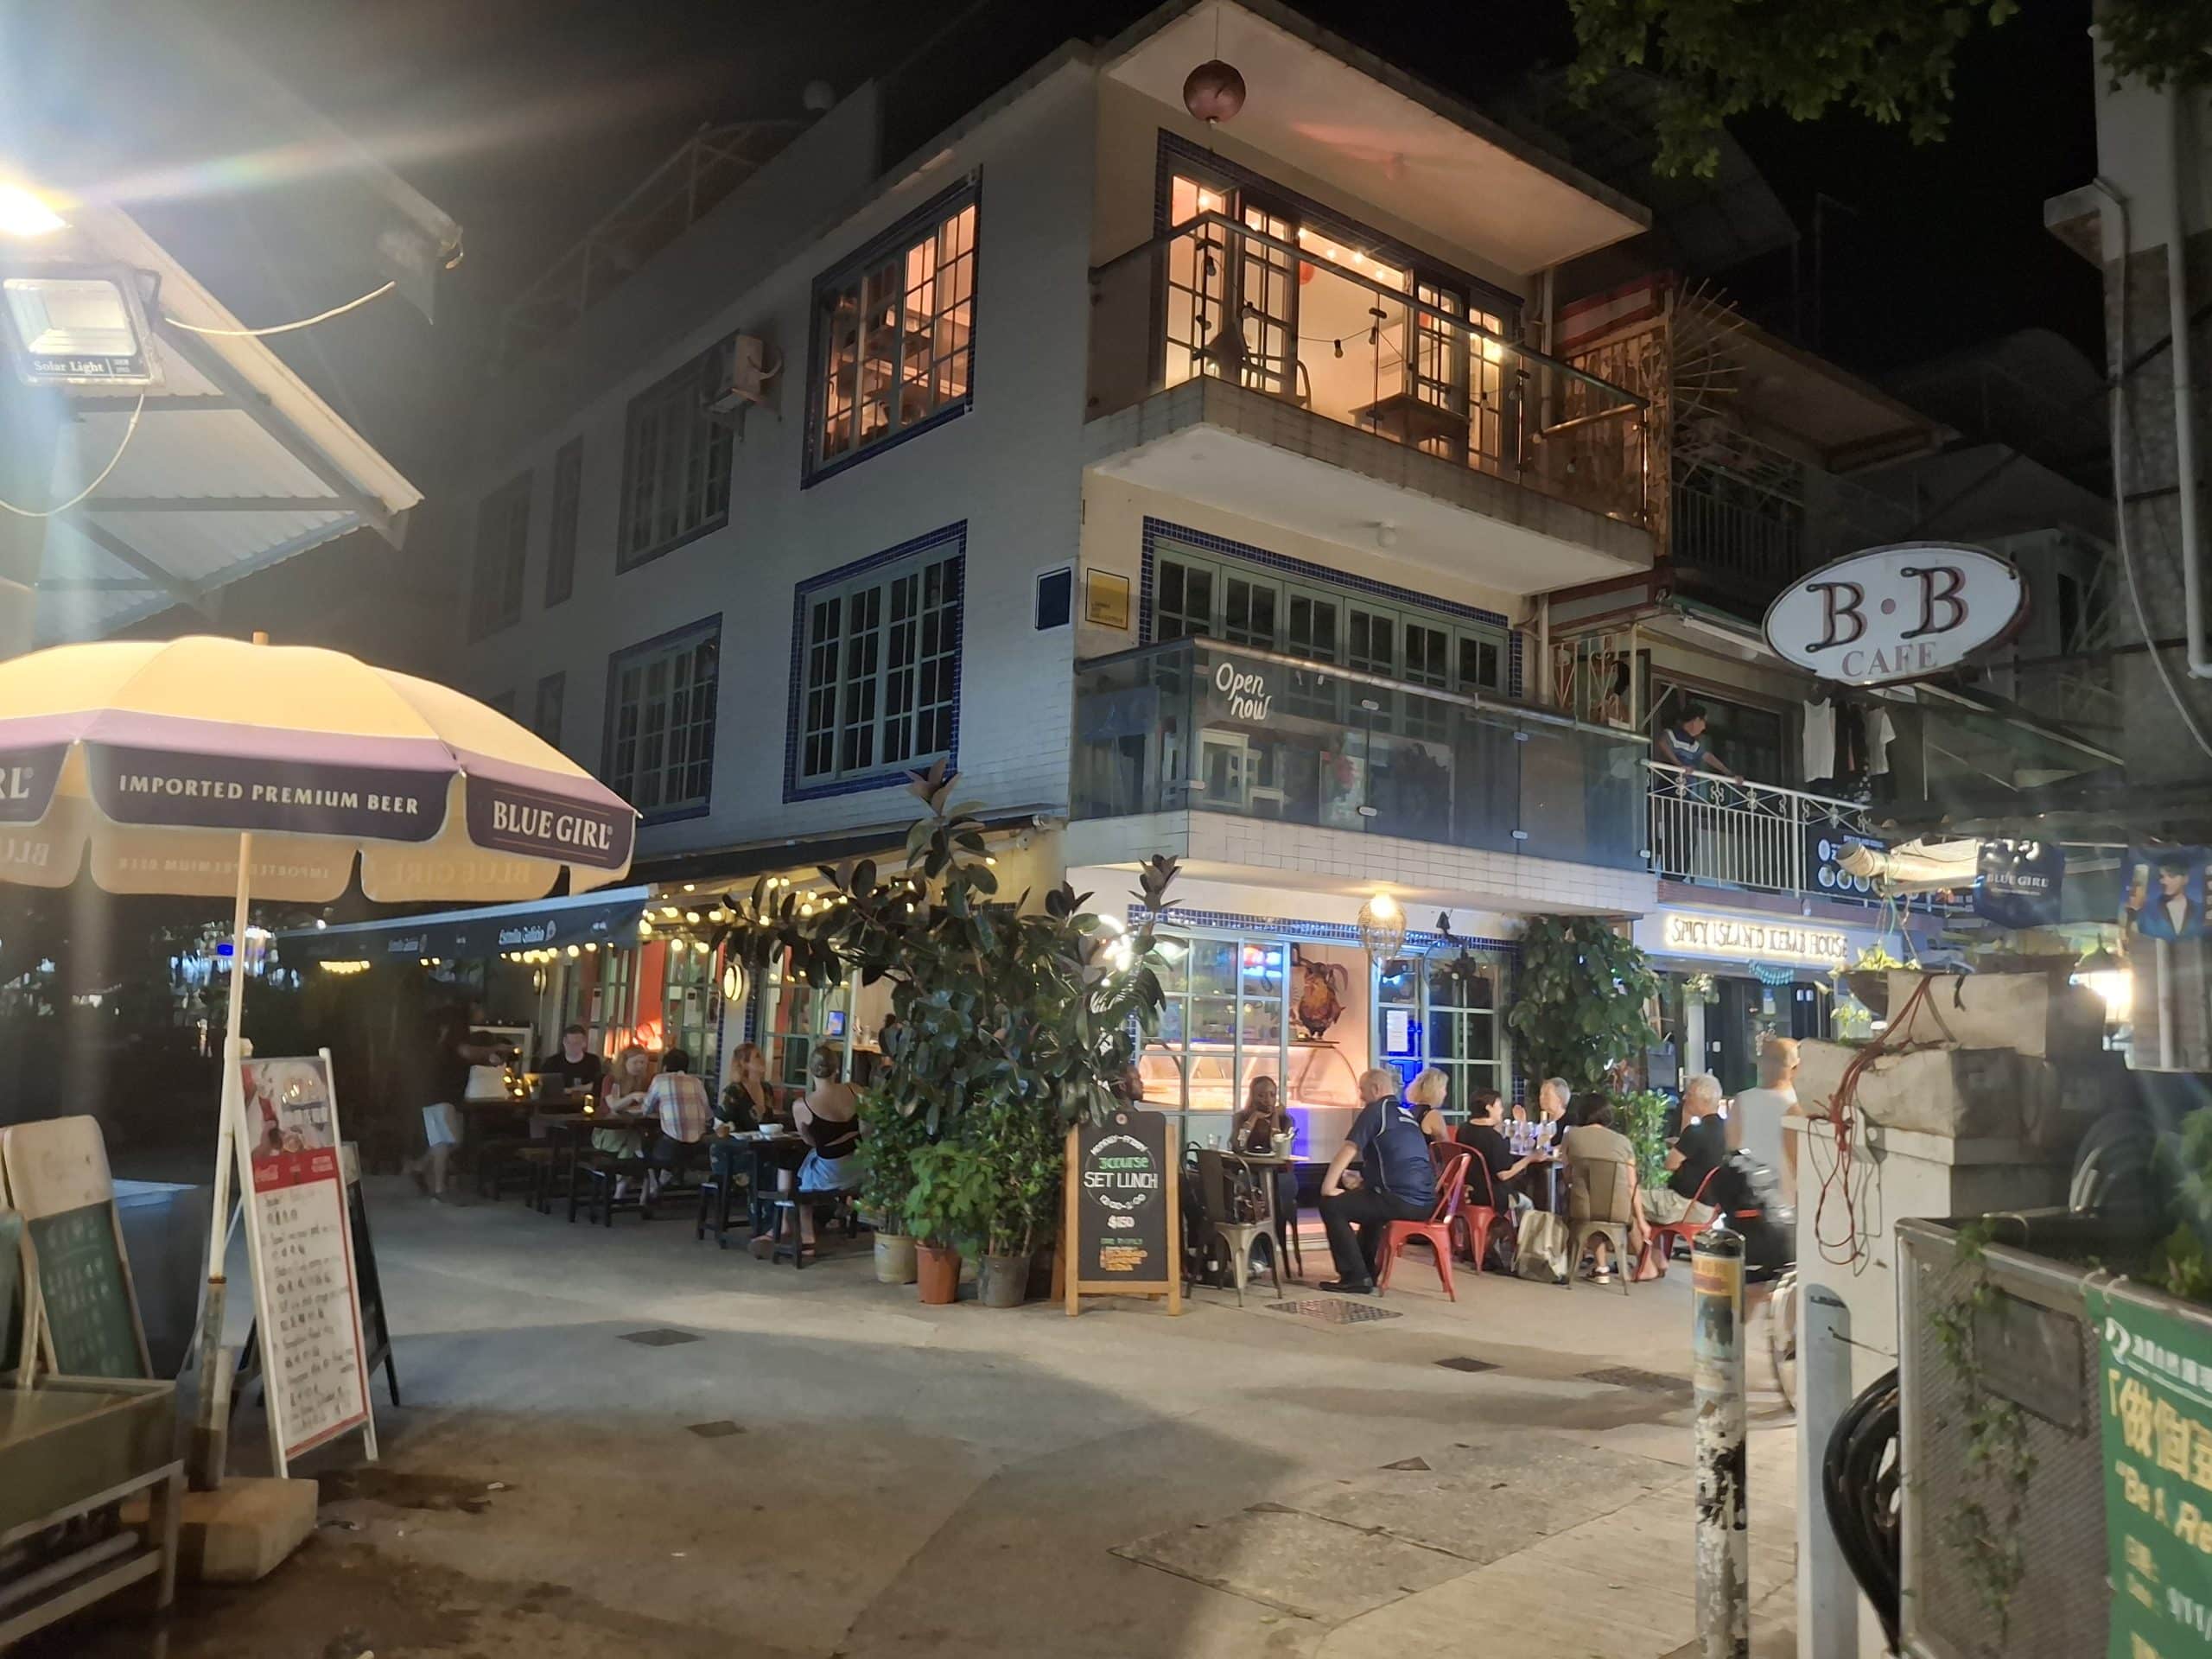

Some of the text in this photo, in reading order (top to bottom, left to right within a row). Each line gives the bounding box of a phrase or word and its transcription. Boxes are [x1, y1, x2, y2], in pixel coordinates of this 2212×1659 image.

[35, 359, 67, 372] Solar
[69, 360, 105, 374] Light
[1841, 641, 1937, 677] CAFE
[1216, 663, 1265, 701] Open
[119, 774, 418, 815] IMPORTED PREMIUM BEER
[493, 800, 610, 849] BLUE GIRL
[2018, 876, 2049, 887] GIRL
[1673, 918, 1708, 944] SPICY
[1714, 922, 1764, 949] ISLAND
[1810, 933, 1848, 957] HOUSE
[1084, 1172, 1159, 1189] SET LUNCH
